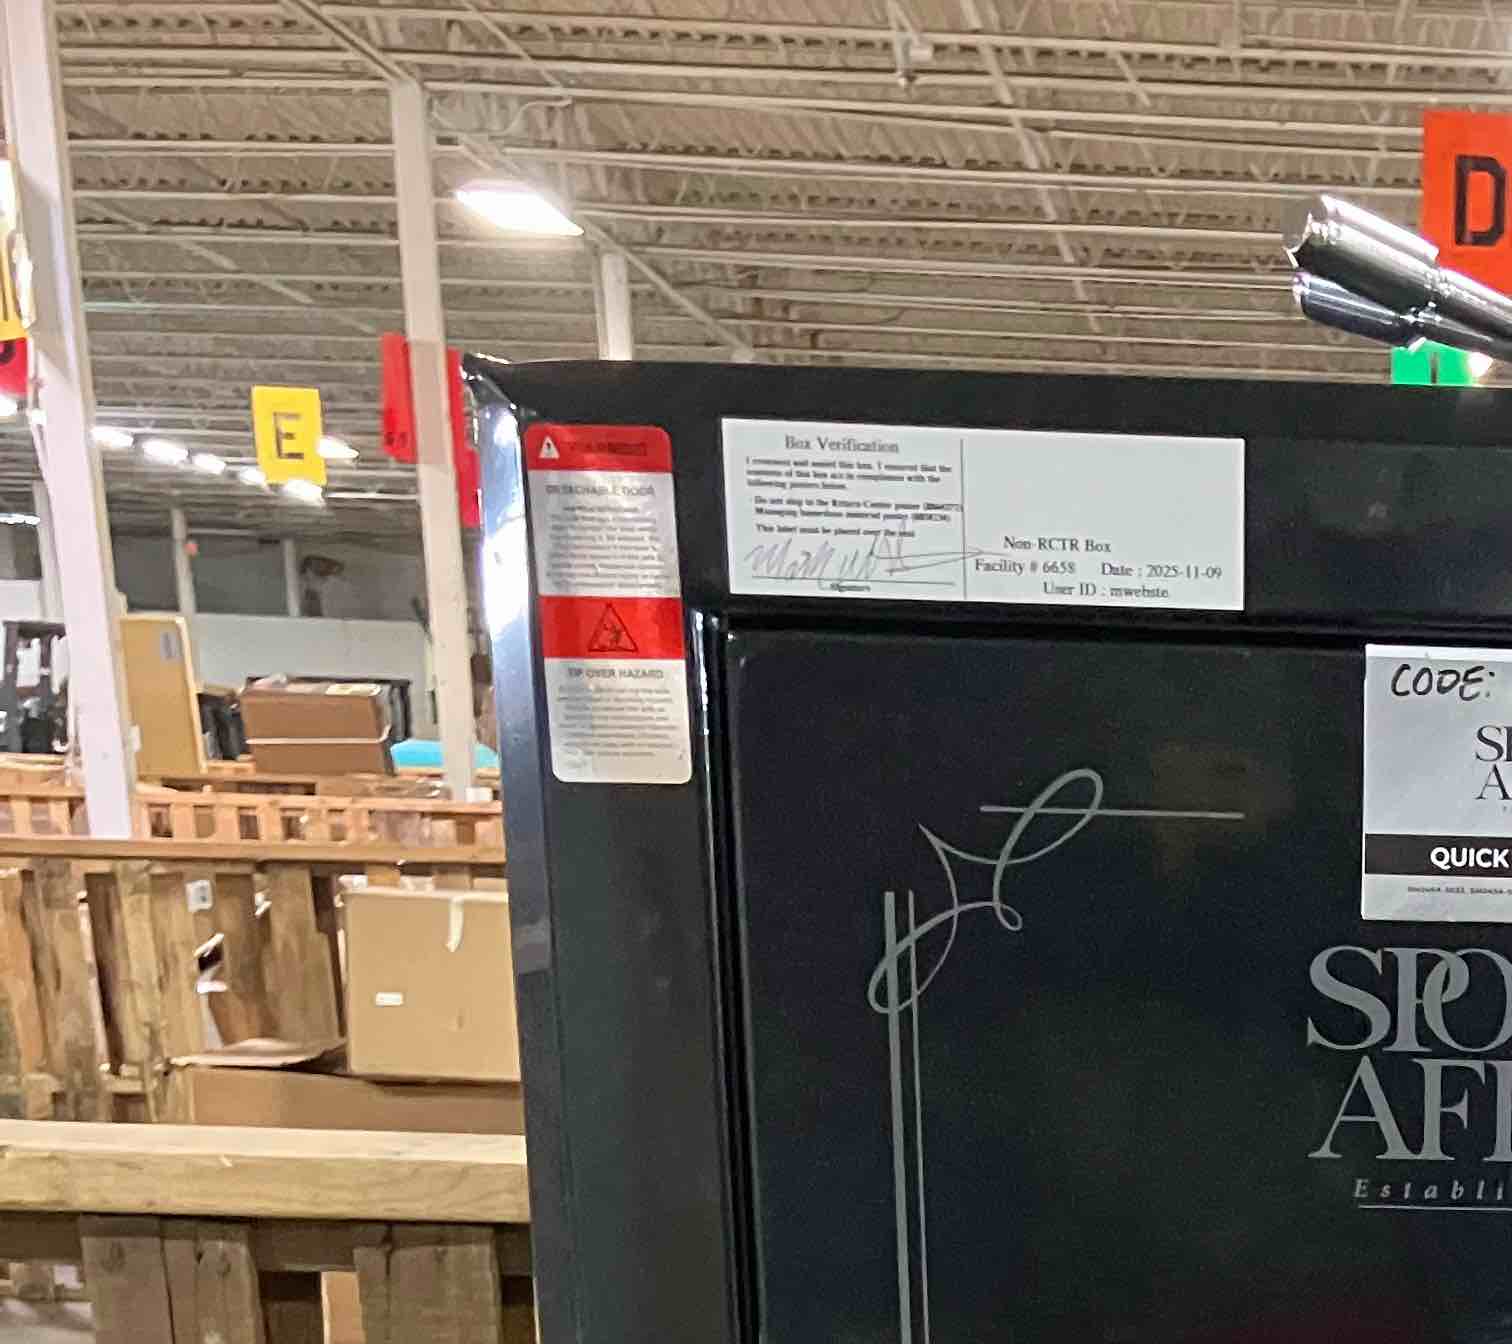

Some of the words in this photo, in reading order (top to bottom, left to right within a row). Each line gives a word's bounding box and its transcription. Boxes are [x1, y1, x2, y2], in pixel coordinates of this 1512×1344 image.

[1454, 154, 1508, 246] D
[273, 411, 304, 460] E
[785, 435, 811, 450] Box
[817, 436, 899, 453] Verification
[1003, 535, 1080, 551] Non-RCTR
[1085, 539, 1112, 553] Box
[975, 558, 1024, 575] Facility
[1101, 562, 1134, 577] Date
[1146, 563, 1223, 579] 2025-11-09
[1043, 581, 1075, 596] User
[1080, 582, 1097, 596] ID
[1391, 663, 1495, 702] CODE:
[1430, 846, 1510, 870] QUICK
